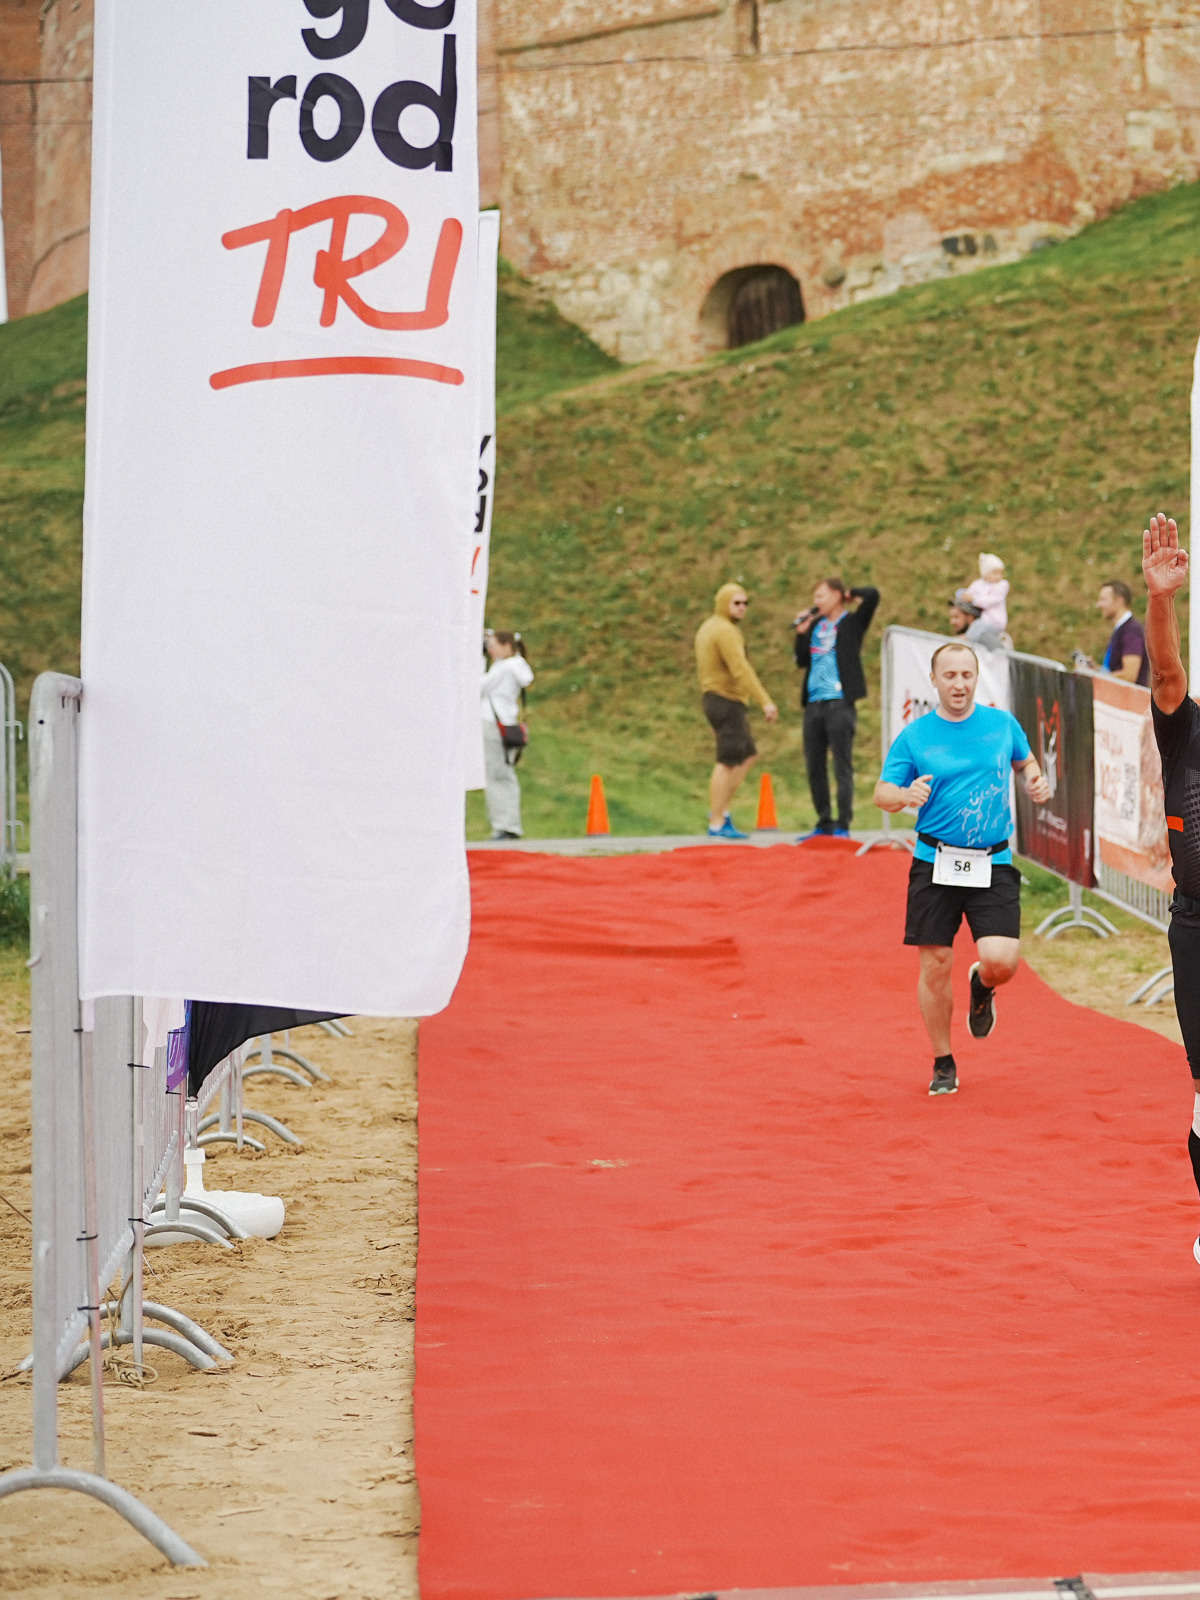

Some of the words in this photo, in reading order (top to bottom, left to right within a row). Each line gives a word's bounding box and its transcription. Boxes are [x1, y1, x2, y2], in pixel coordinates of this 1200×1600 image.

[246, 34, 457, 172] rod
[221, 194, 463, 331] TRI
[954, 860, 971, 872] 58
